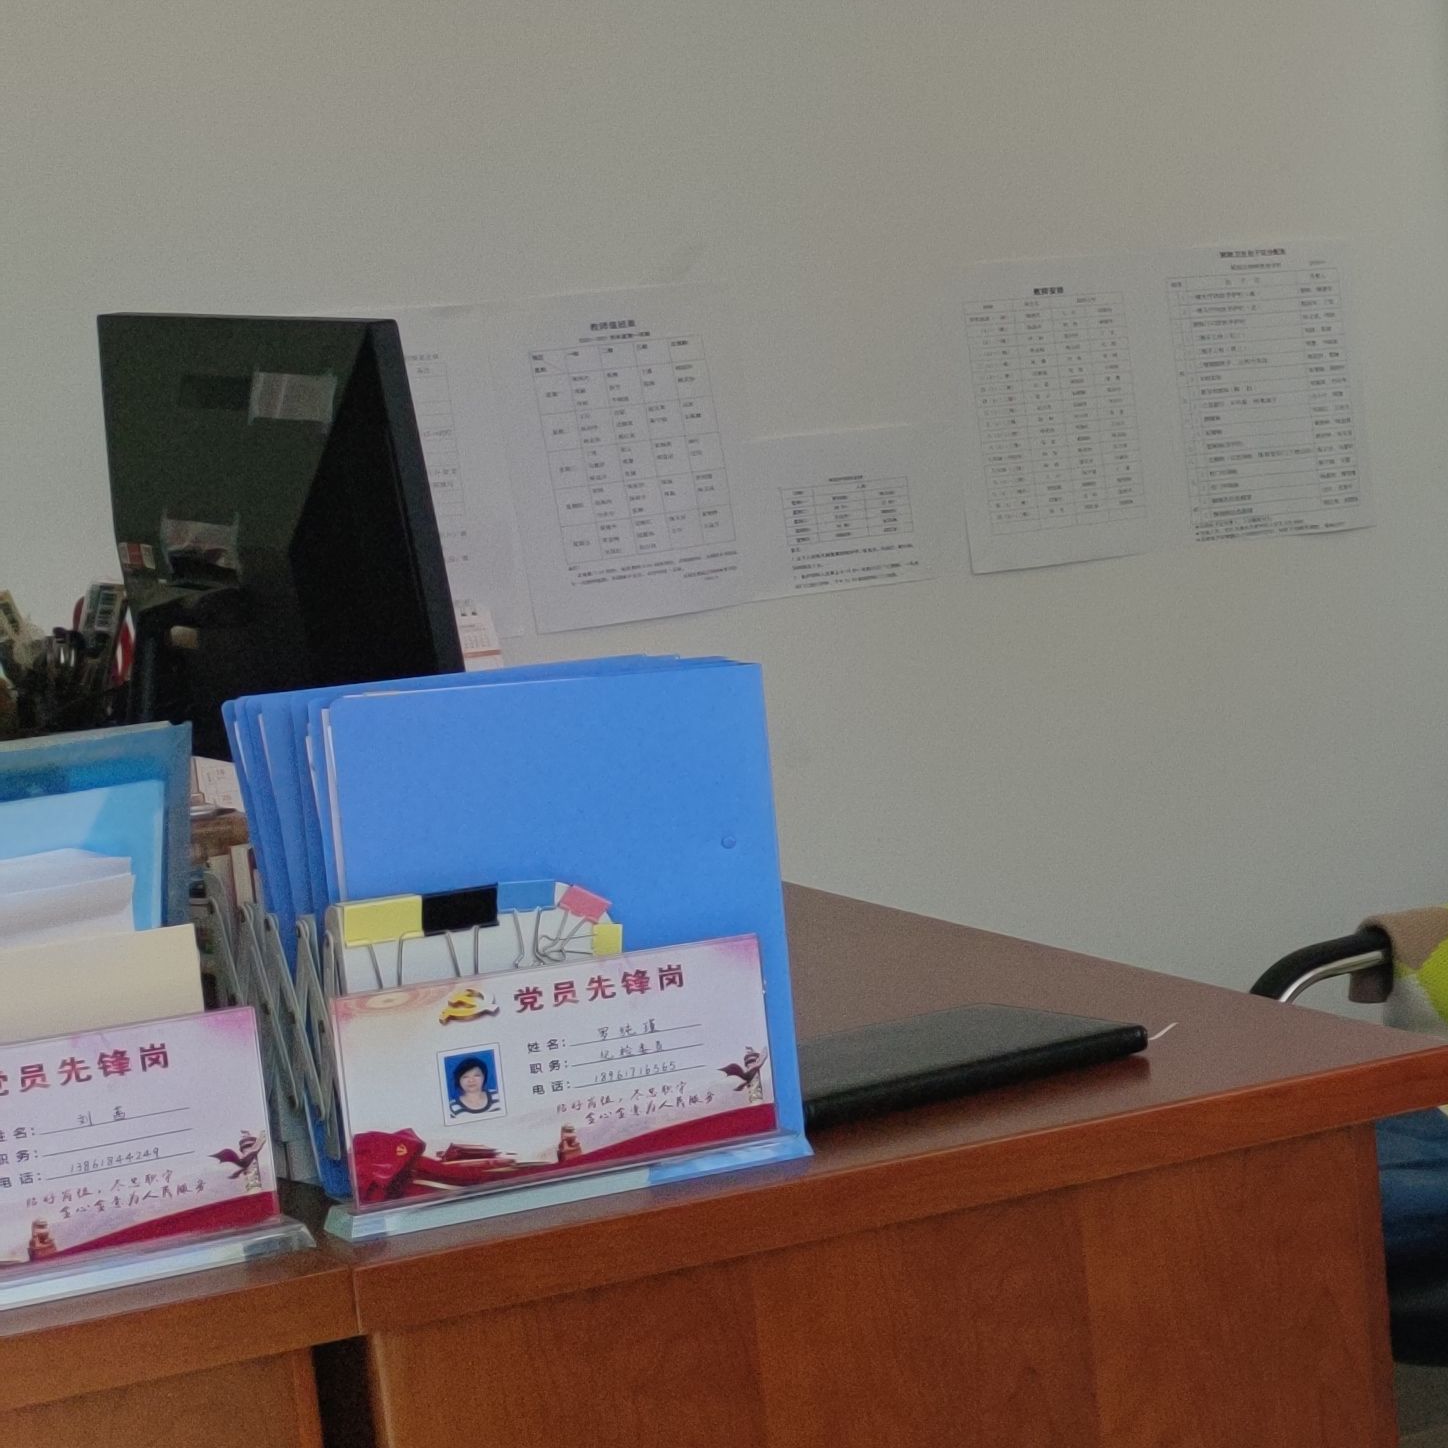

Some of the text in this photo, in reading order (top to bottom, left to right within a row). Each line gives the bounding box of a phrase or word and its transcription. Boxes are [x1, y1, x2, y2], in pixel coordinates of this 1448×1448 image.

[513, 964, 685, 1014] 党员先锋岗
